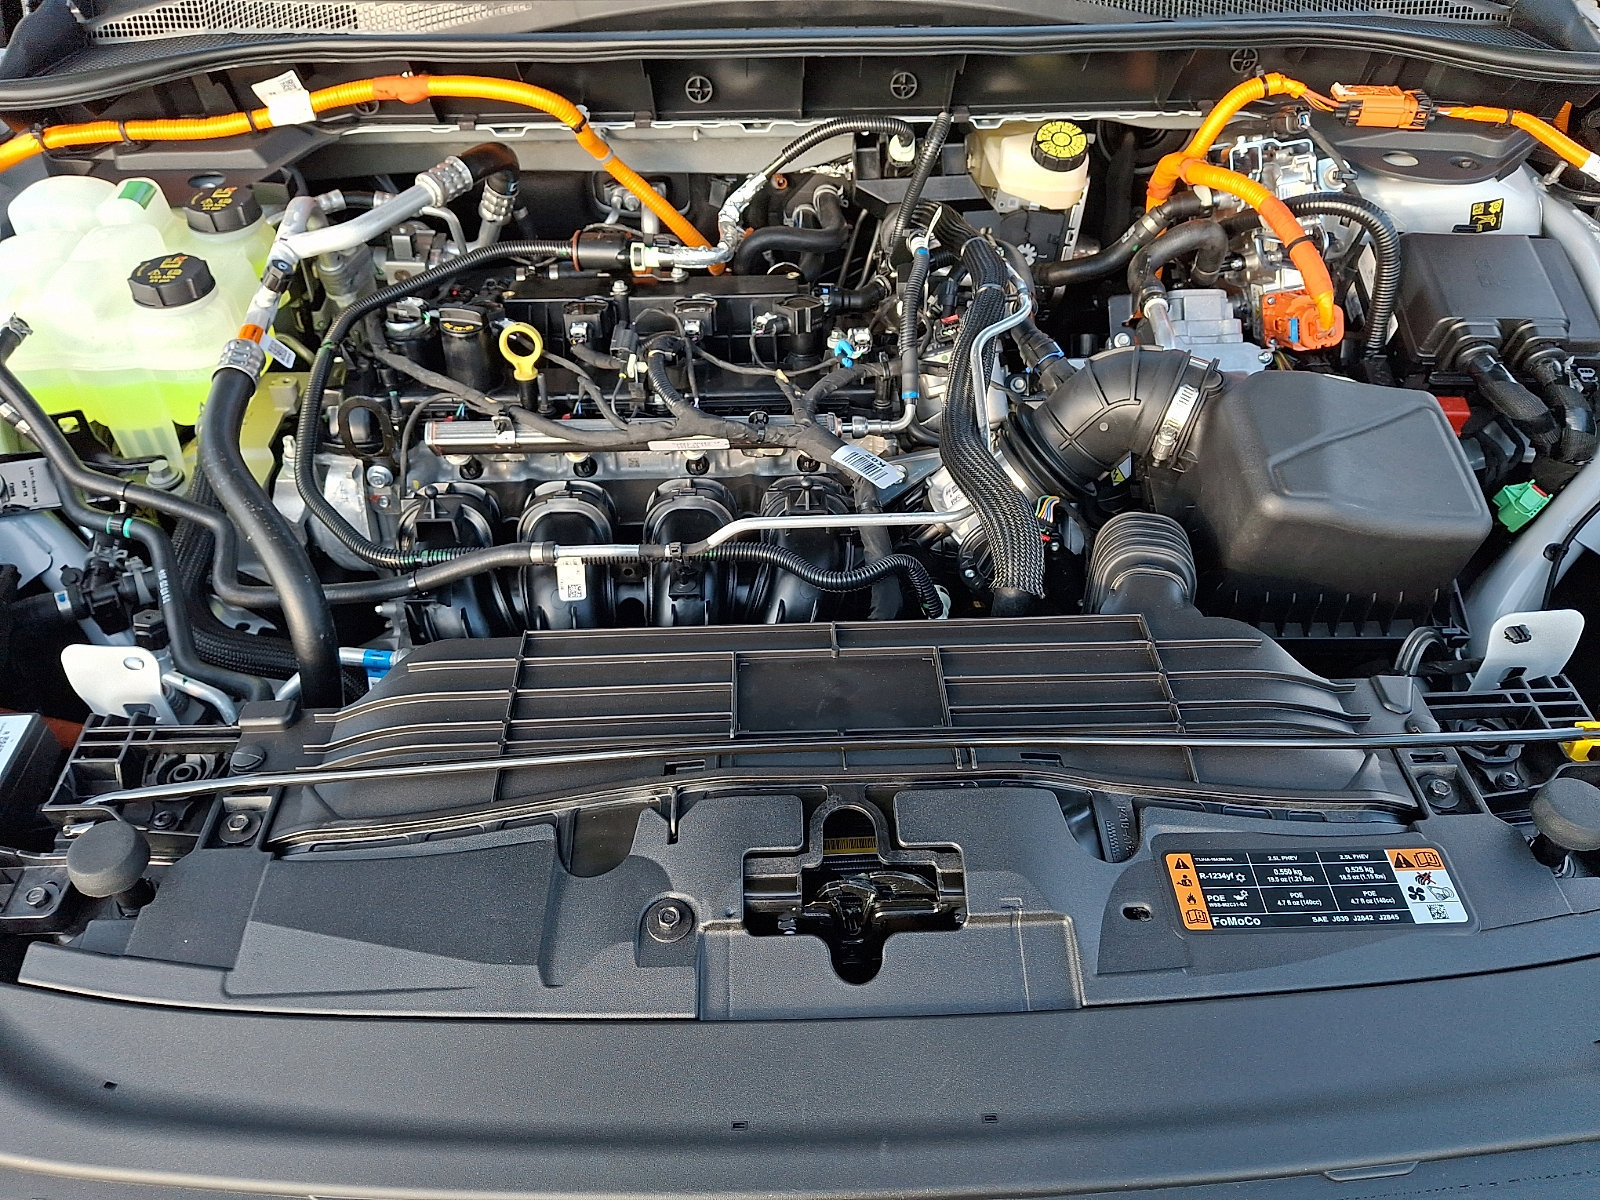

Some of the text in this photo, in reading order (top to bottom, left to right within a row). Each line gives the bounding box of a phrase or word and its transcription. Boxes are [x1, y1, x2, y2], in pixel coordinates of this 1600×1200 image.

[1273, 868, 1303, 877] 0.550 kg
[1364, 866, 1375, 874] kg
[1198, 872, 1235, 881] R-1234yf
[1288, 875, 1302, 883] (1.21
[1302, 875, 1315, 883] lbs)
[1206, 894, 1227, 902] POE
[1213, 916, 1261, 926] FoMoCo
